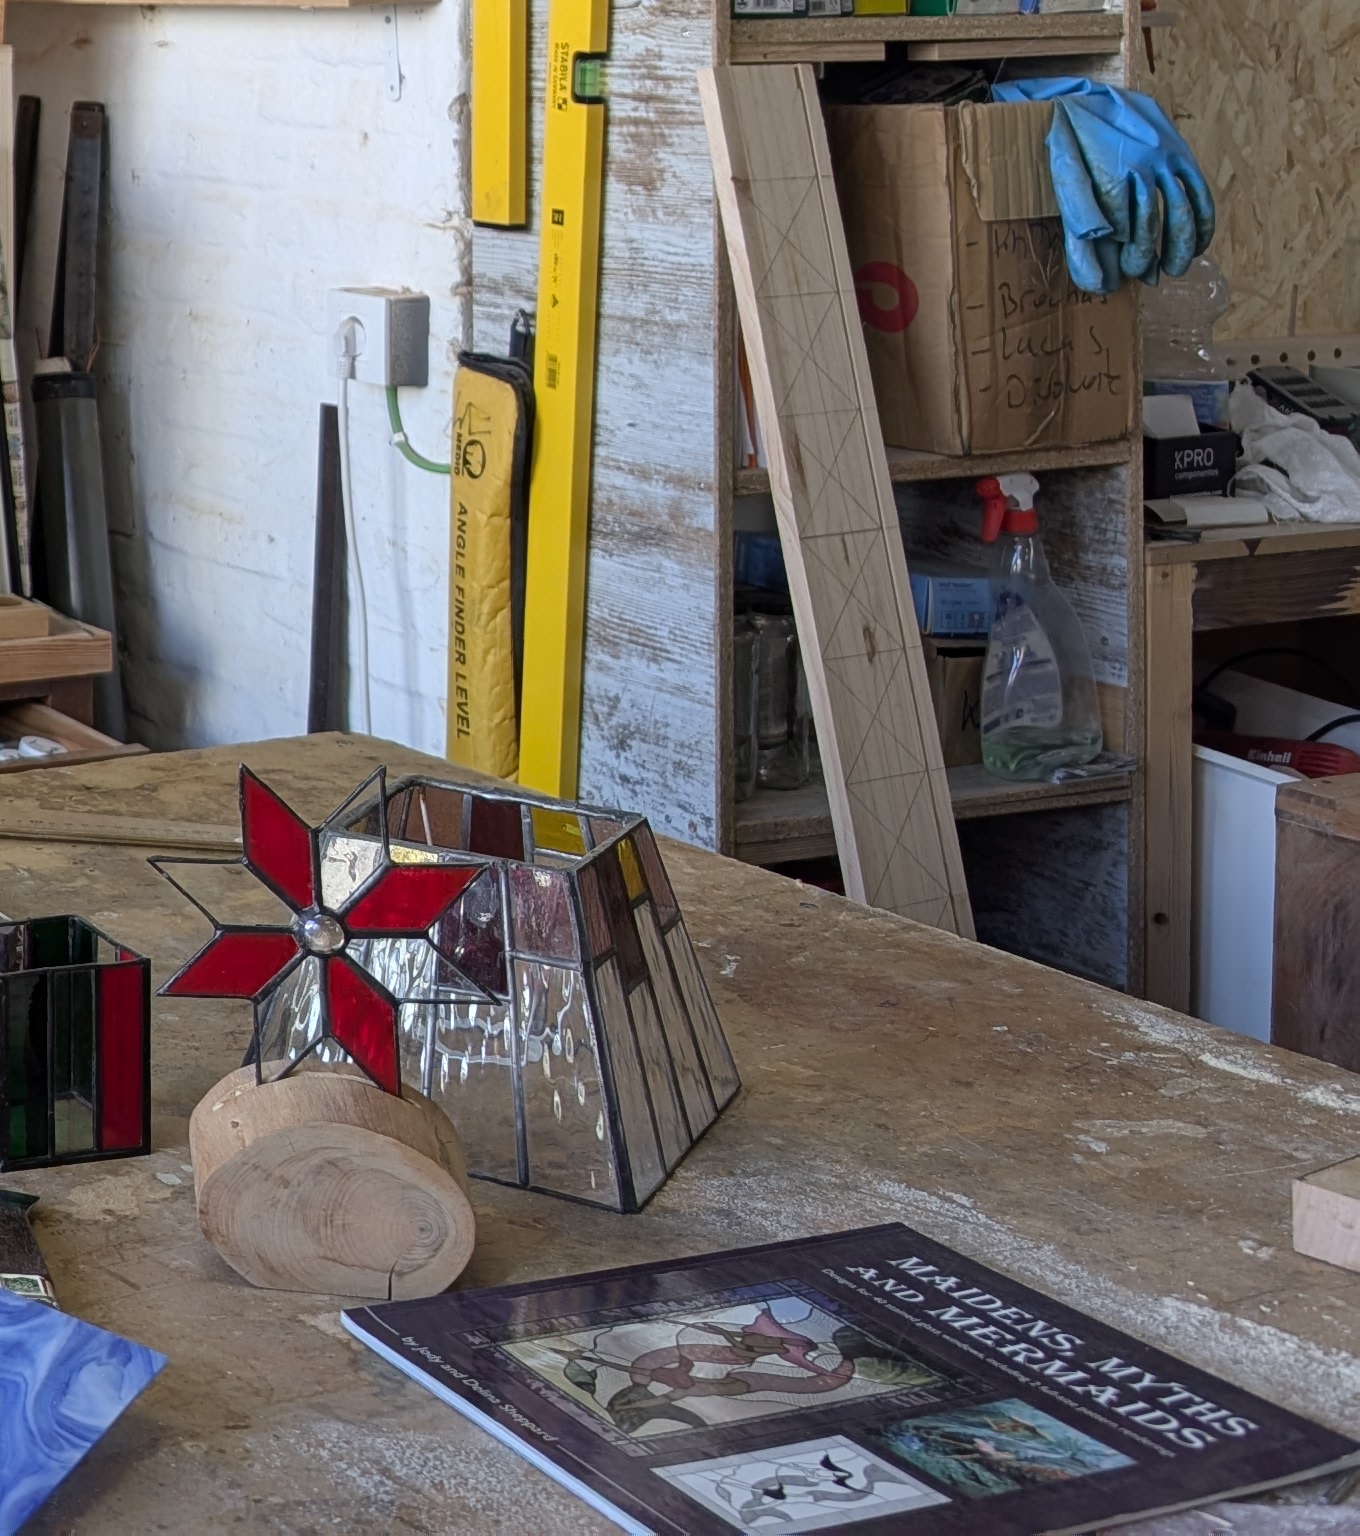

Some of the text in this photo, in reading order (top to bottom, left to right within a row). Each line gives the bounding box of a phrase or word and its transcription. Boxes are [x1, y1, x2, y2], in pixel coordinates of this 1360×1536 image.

[1174, 448, 1214, 470] KPRO
[453, 501, 471, 740] ANGLE FINDER LEVEL
[1247, 749, 1292, 764] Einhell
[401, 1336, 419, 1347] by
[440, 1364, 469, 1379] and
[499, 1403, 559, 1442] Sheppard
[845, 1265, 1218, 1451] AND MERMAIDS
[886, 1255, 1260, 1439] MAIDENS, MYTHS
